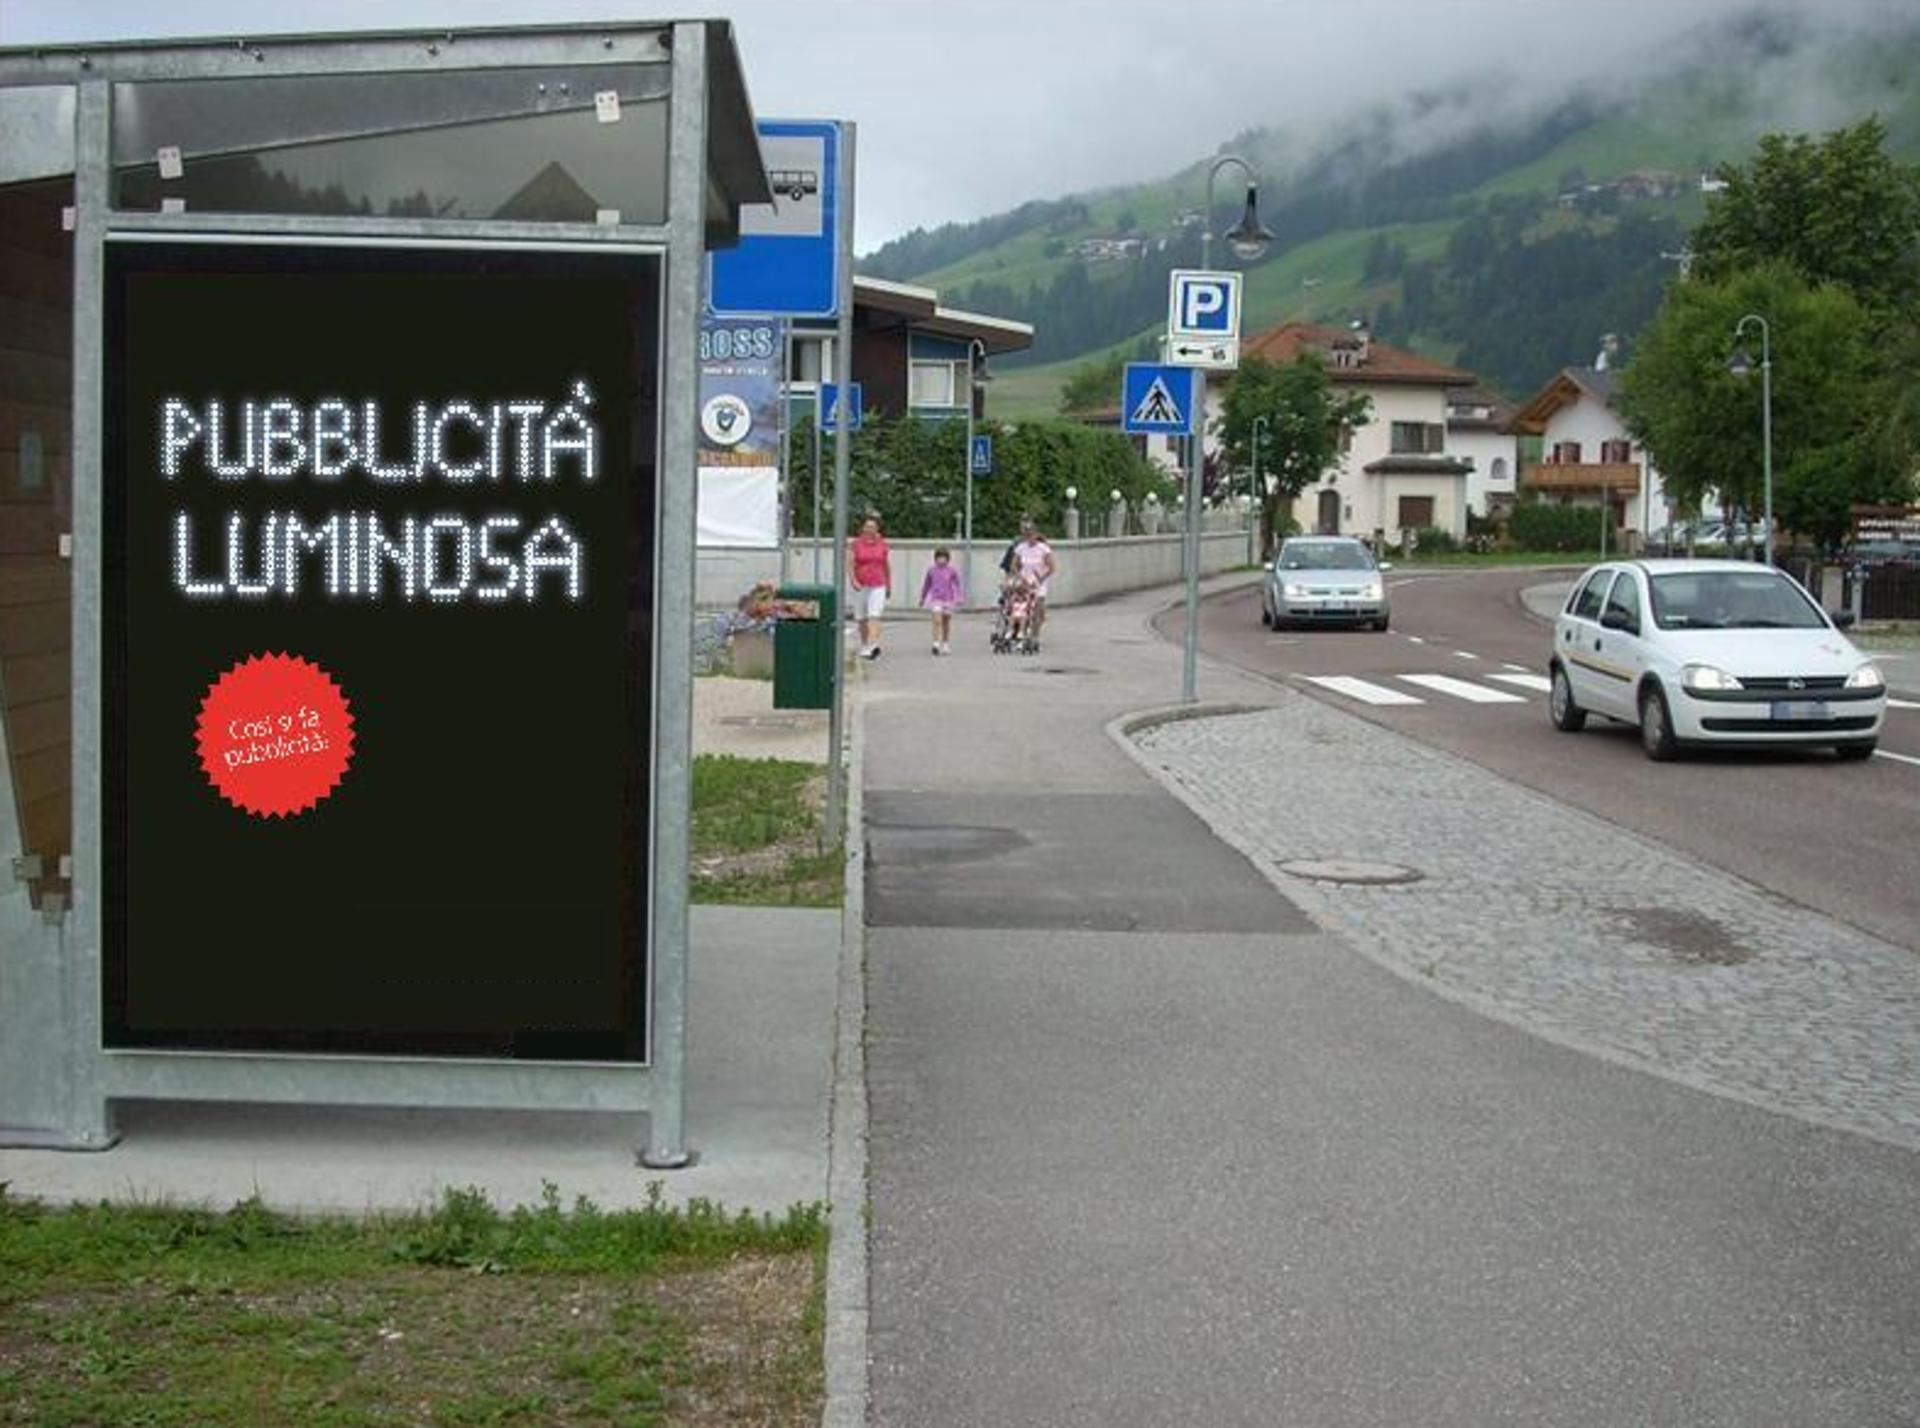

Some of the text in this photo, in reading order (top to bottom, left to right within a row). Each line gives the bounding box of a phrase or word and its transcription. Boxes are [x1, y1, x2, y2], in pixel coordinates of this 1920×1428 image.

[1186, 284, 1223, 327] P
[174, 512, 585, 601] LUMINOSA
[298, 705, 319, 728] fa
